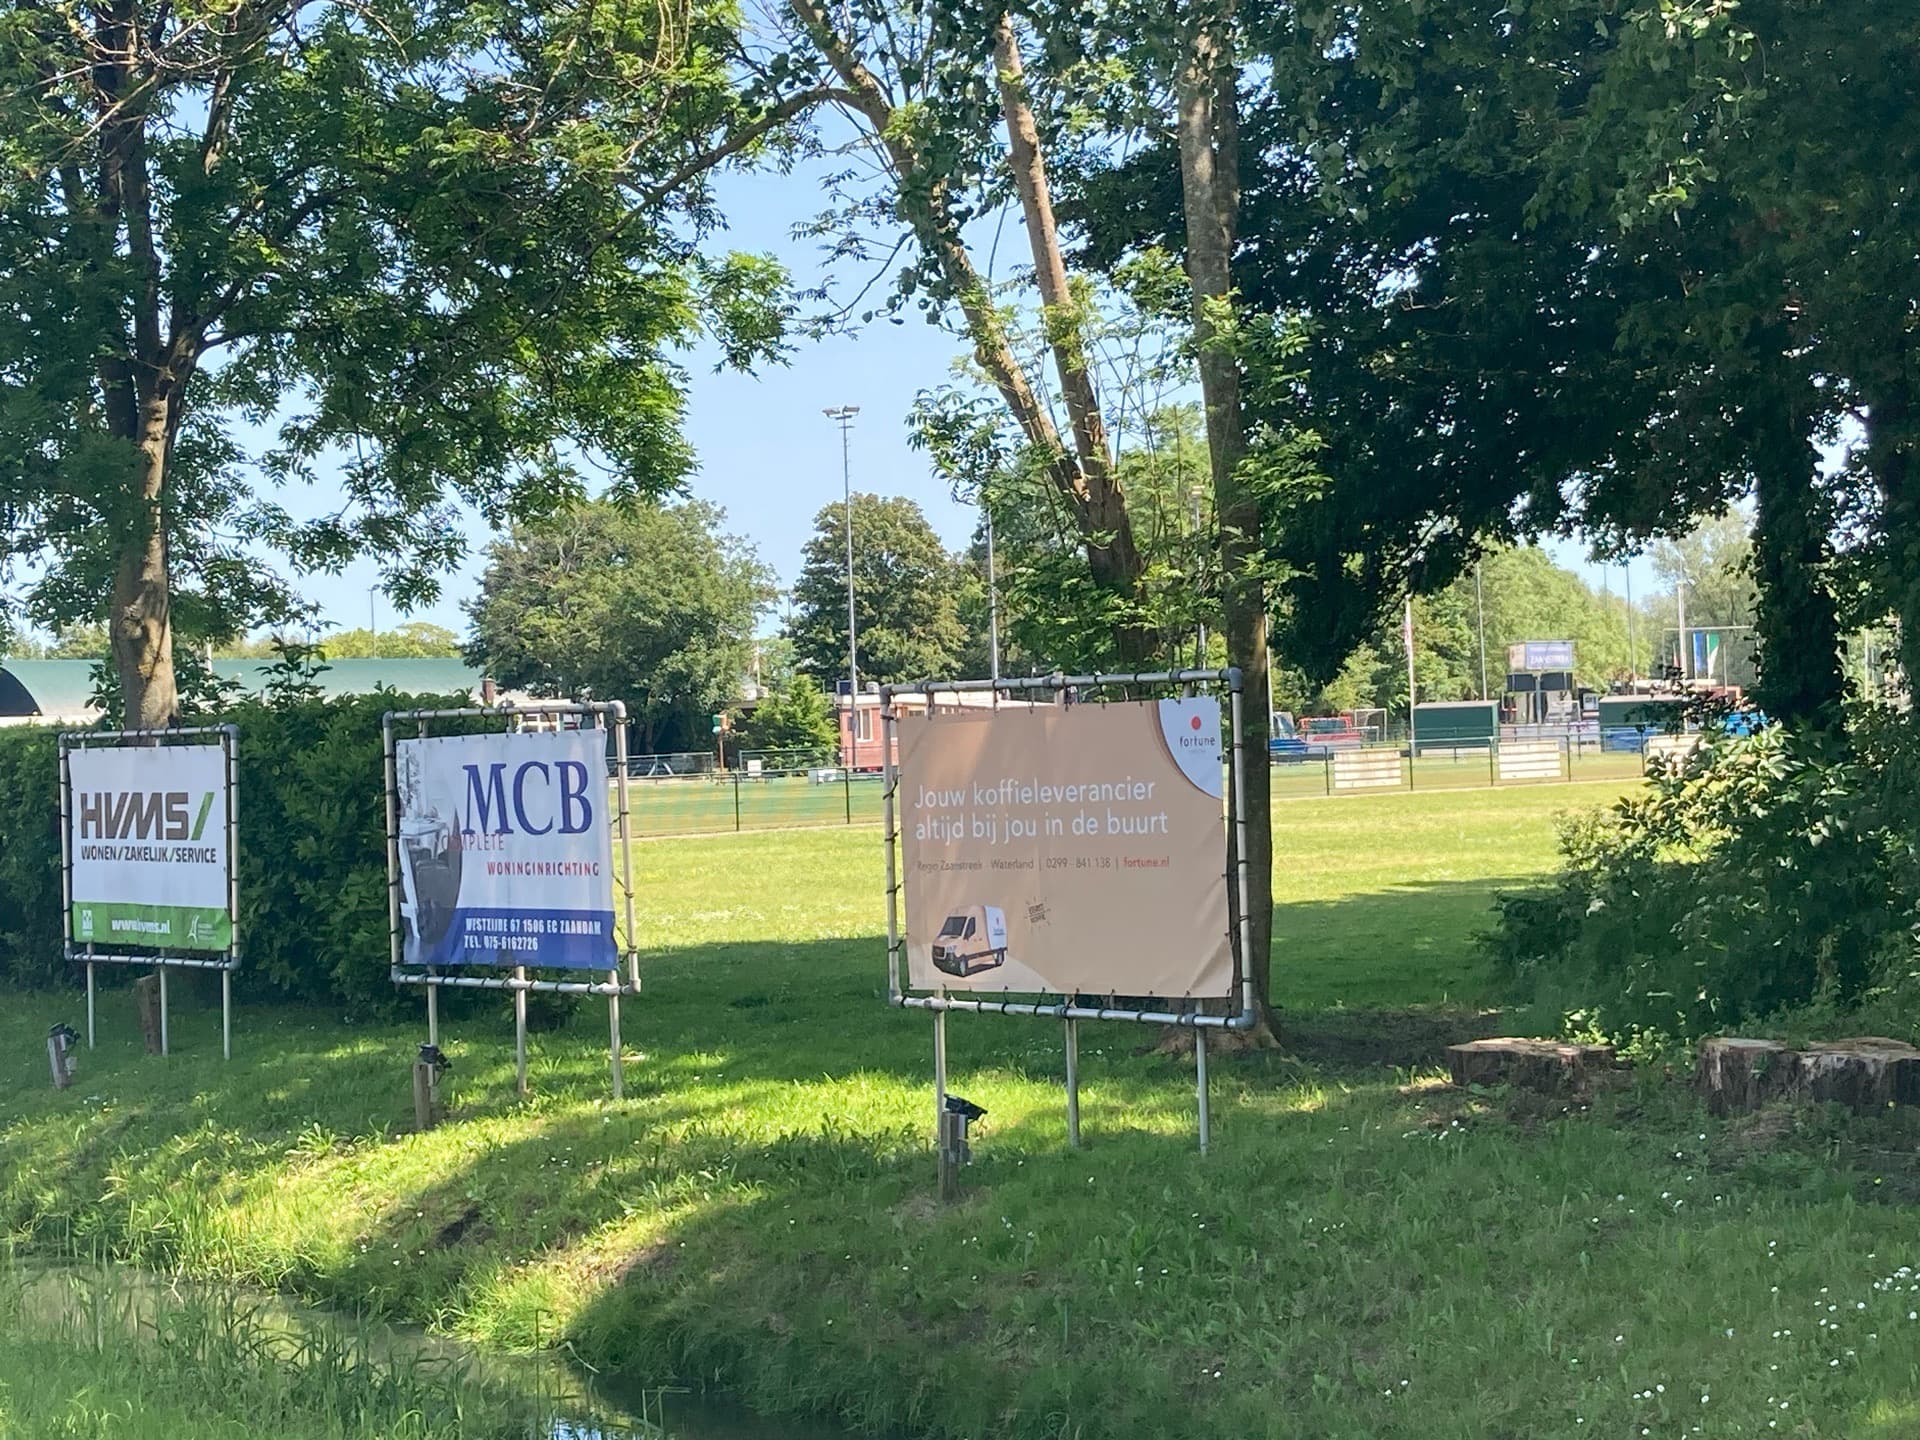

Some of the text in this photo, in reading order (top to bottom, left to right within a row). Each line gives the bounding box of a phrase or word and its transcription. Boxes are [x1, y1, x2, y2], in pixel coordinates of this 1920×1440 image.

[1179, 735, 1216, 748] fortune
[462, 760, 594, 836] MCB
[914, 775, 1156, 809] Jouw koffieleverancier
[915, 806, 1169, 846] altijd bij jou in de buurt
[487, 861, 600, 877] WONINGINRICHTING
[990, 858, 1034, 870] Waterland
[1046, 857, 1068, 869] 0299
[510, 919, 521, 933] 67
[523, 919, 545, 934] 1506
[546, 920, 558, 933] EC
[559, 920, 602, 936] ZAANDAM
[483, 935, 539, 951] 075-6162726
